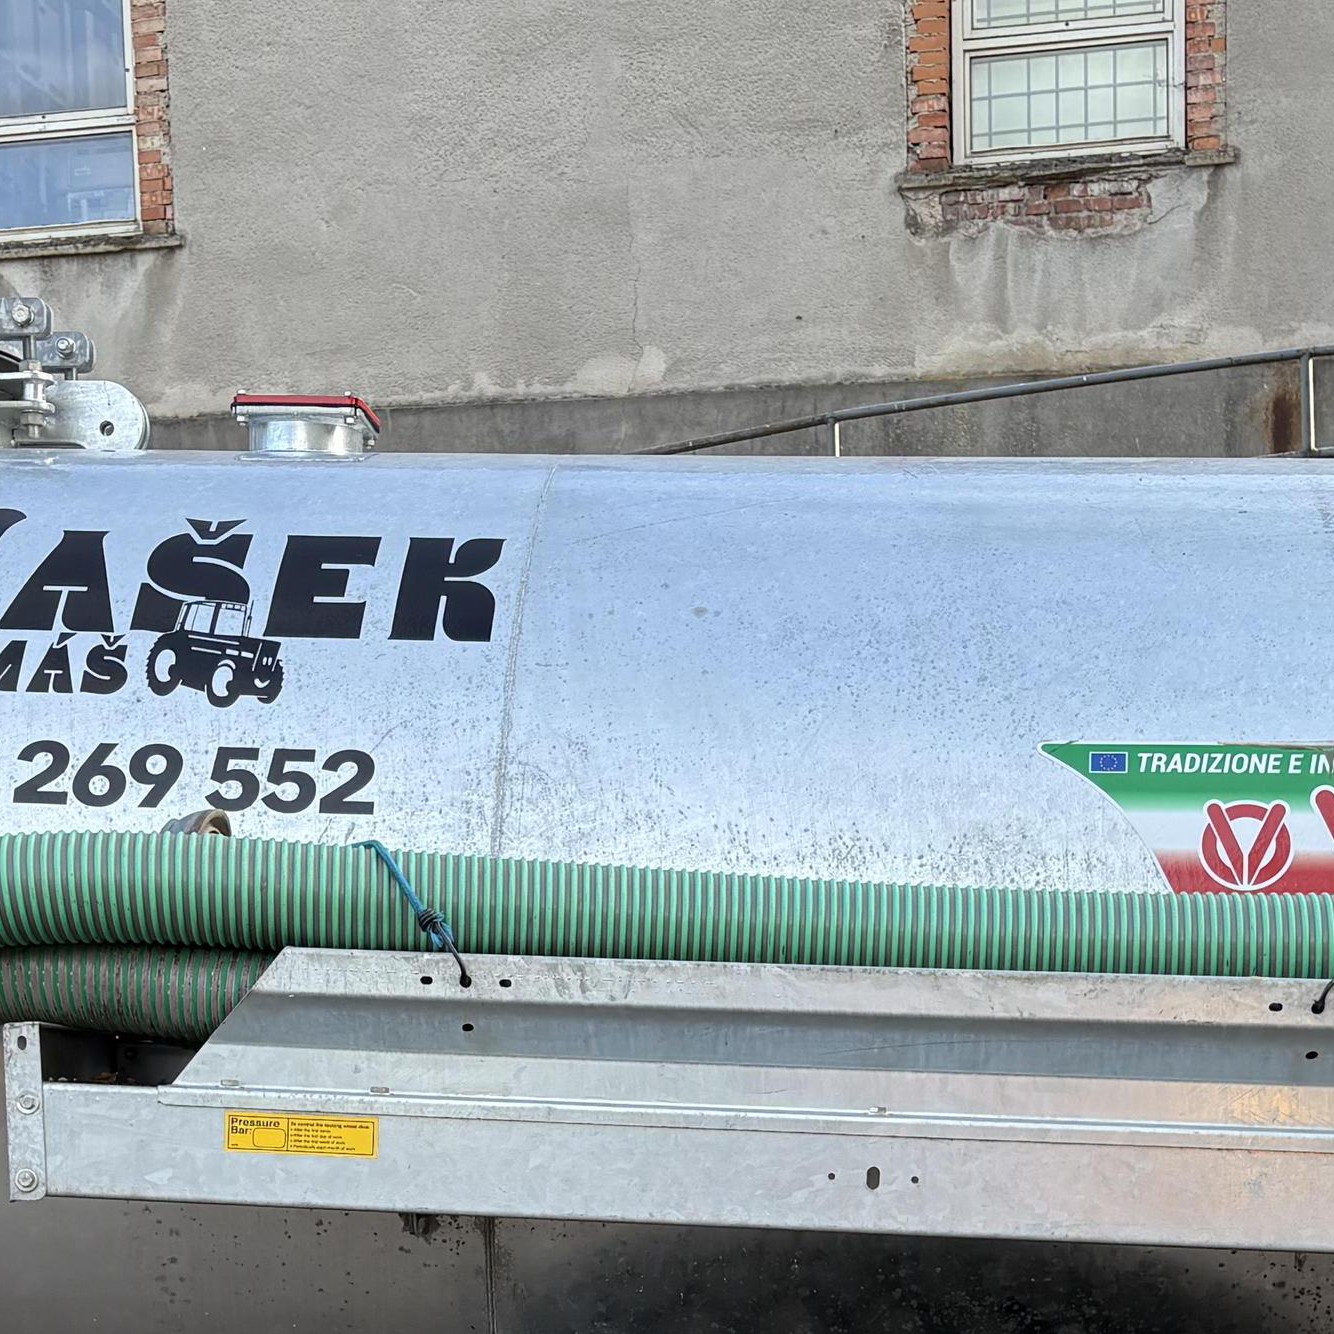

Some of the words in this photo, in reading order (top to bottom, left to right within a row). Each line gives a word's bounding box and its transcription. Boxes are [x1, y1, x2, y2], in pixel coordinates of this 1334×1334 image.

[1137, 751, 1284, 776] TRADIZIONE
[1288, 752, 1304, 775] E
[13, 740, 183, 808] 269
[204, 746, 375, 815] 552
[230, 1117, 280, 1128] Pressure
[230, 1126, 252, 1135] Bar:
